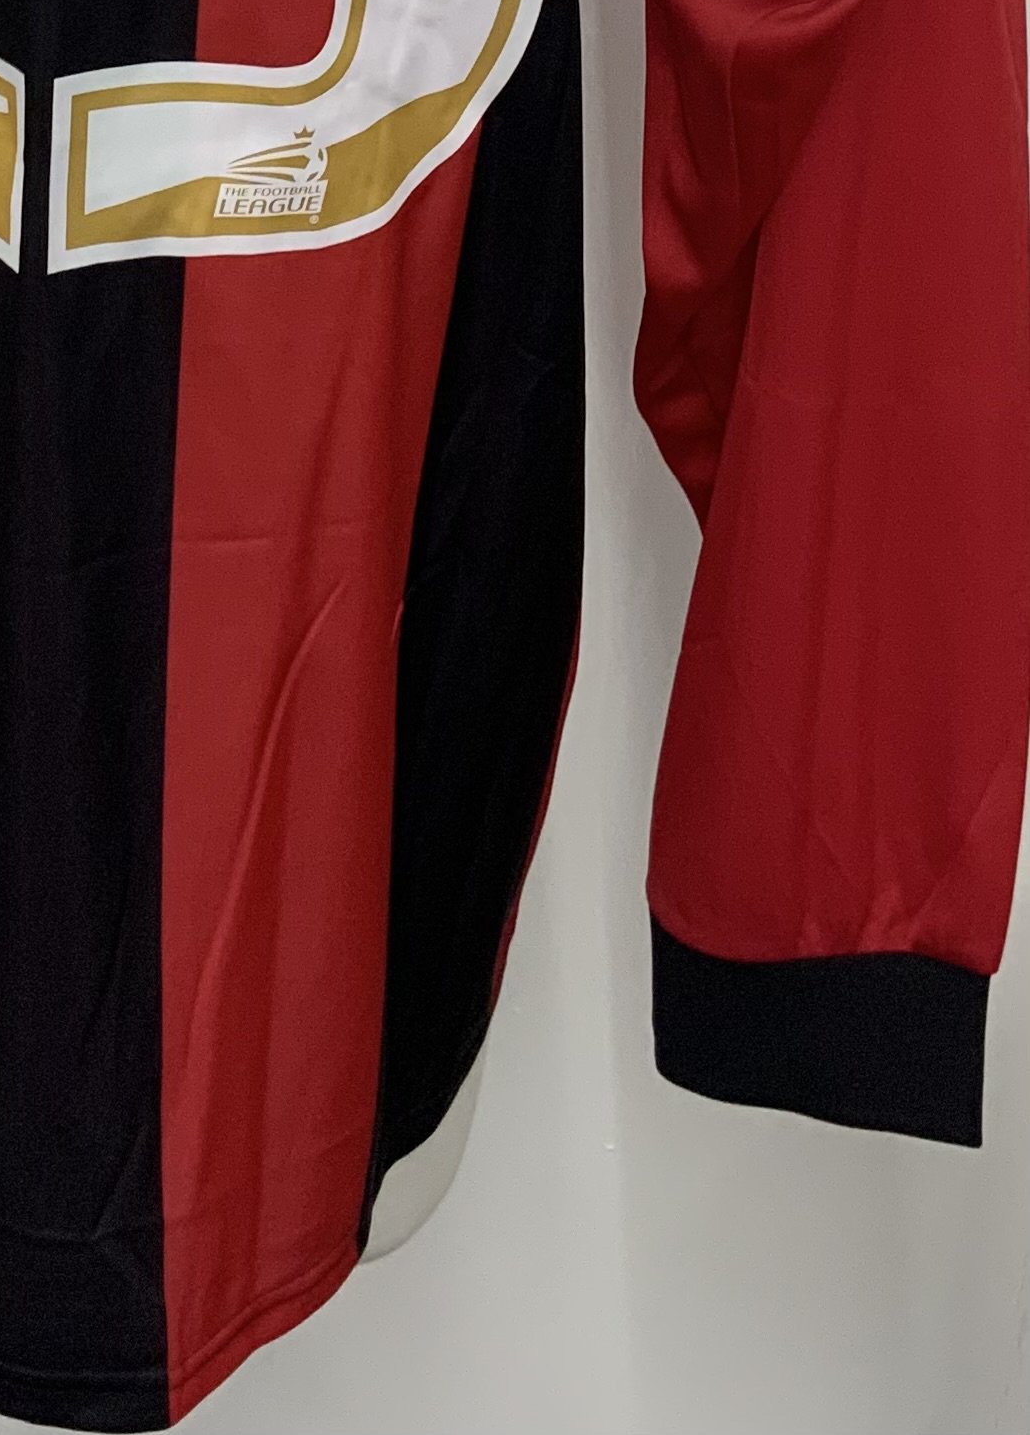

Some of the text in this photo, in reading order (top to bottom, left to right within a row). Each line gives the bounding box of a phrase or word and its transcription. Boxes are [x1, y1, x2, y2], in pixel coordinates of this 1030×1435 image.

[224, 185, 321, 196] THE FOOTBALL
[219, 195, 320, 215] LEAGUE
